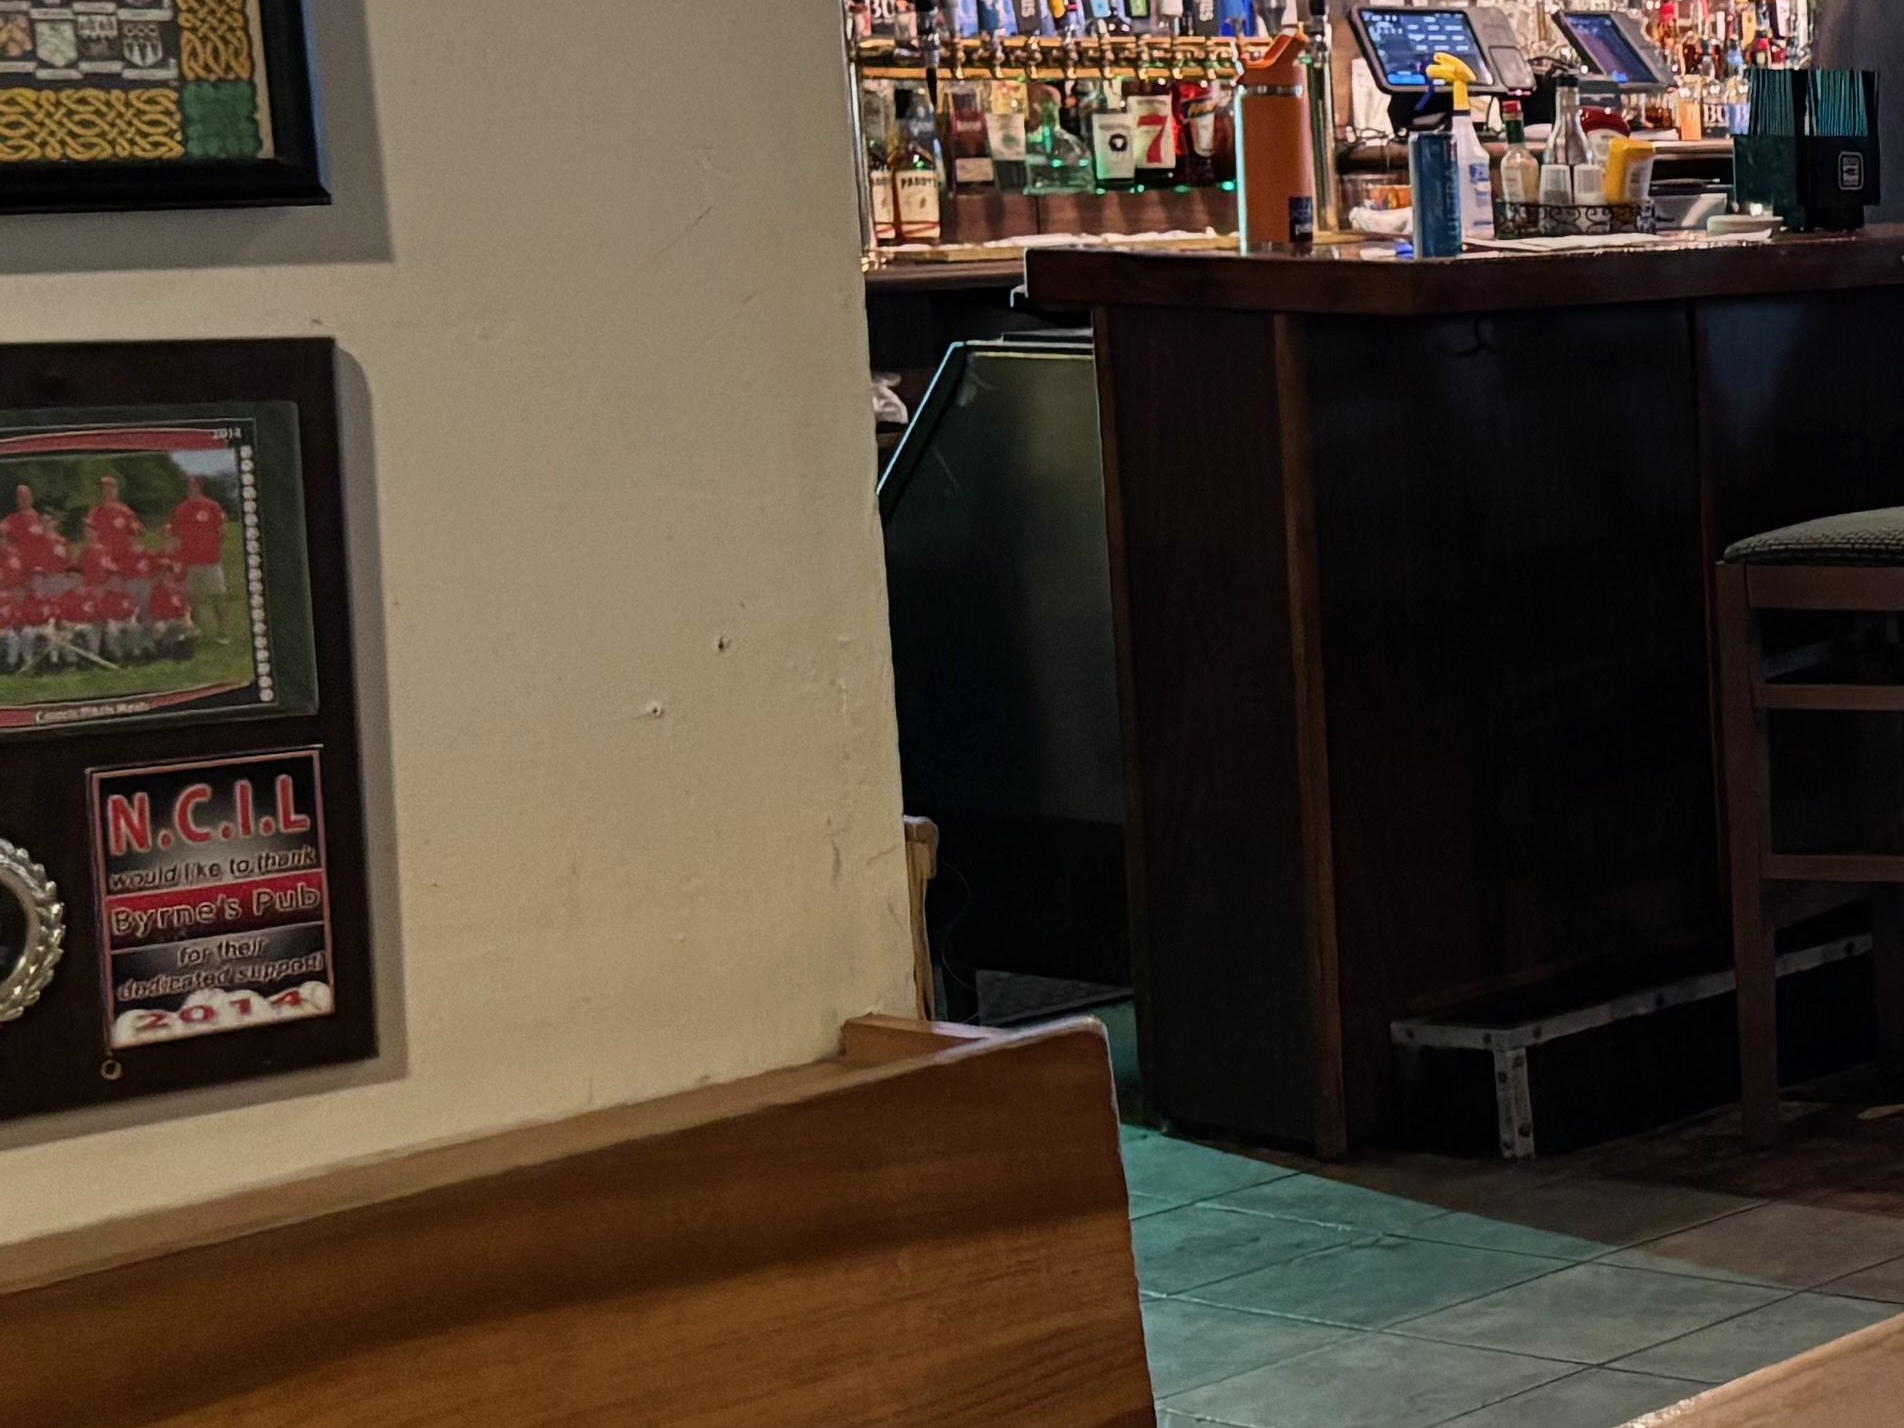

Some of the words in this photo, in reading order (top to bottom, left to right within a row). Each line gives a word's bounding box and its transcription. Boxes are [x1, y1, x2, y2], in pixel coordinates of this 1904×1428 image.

[1136, 115, 1169, 164] 7
[106, 773, 310, 857] N.C.I.L
[108, 864, 178, 895] would
[182, 859, 221, 882] like
[228, 854, 250, 880] to
[256, 844, 318, 874] thank
[111, 893, 242, 938] Byrne's
[252, 882, 322, 917] Pub
[116, 969, 233, 1002] dedicated
[237, 952, 325, 985] support
[176, 947, 211, 967] for
[217, 938, 268, 959] their
[134, 989, 307, 1032] 2014
